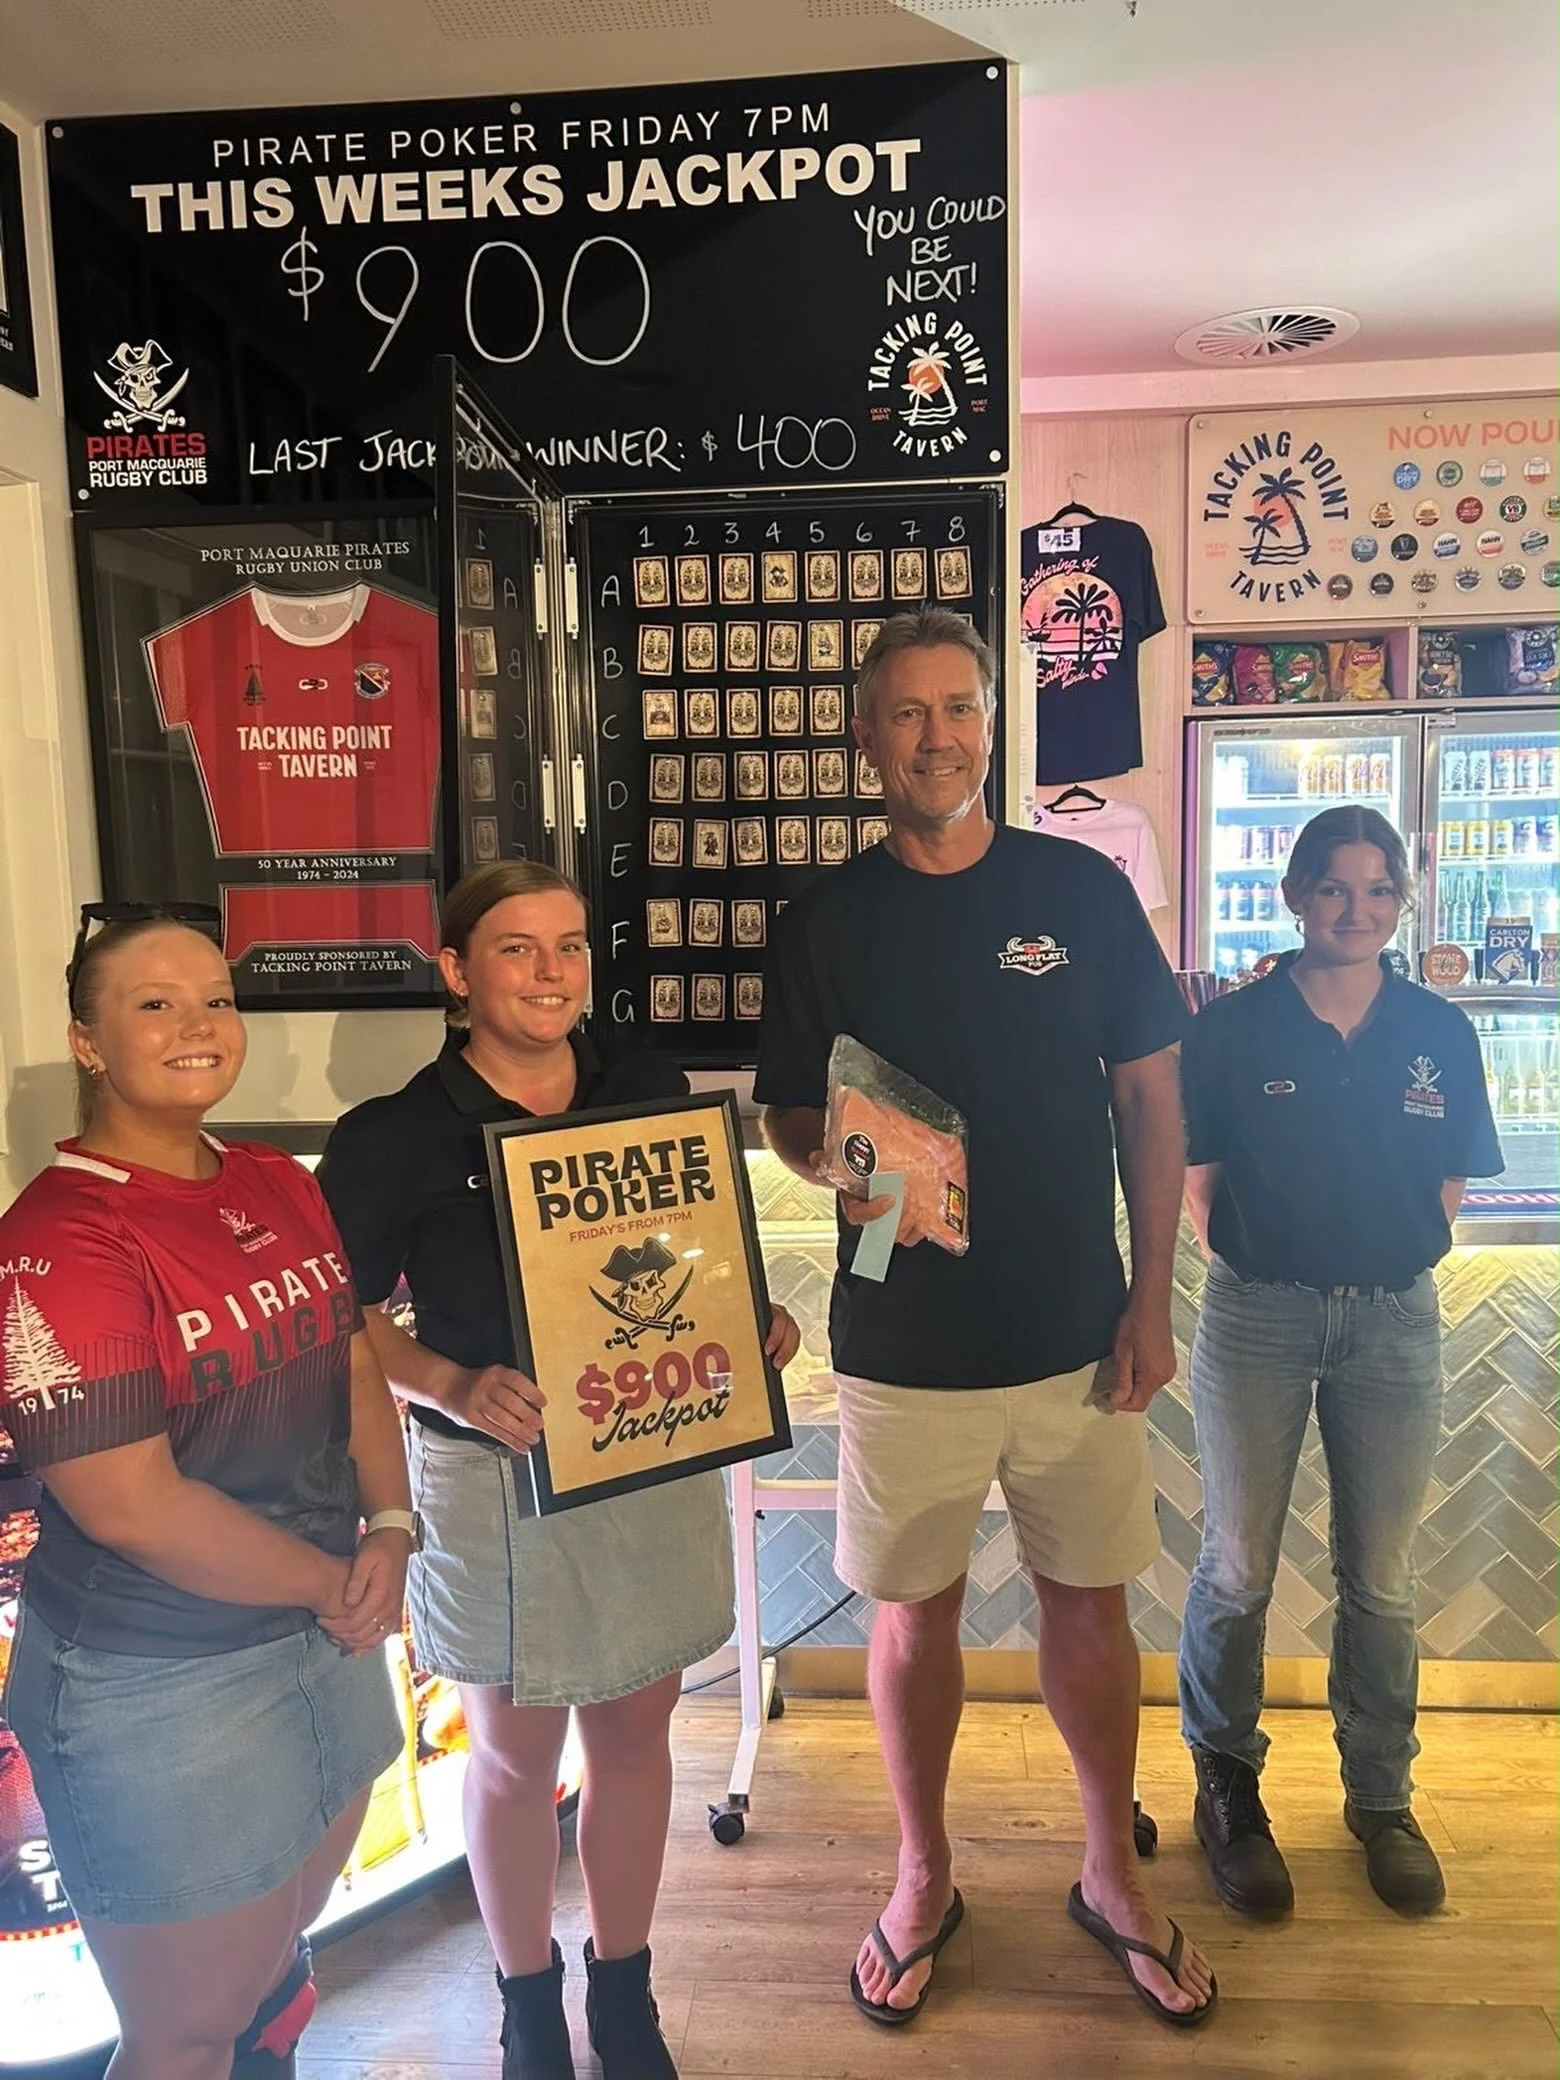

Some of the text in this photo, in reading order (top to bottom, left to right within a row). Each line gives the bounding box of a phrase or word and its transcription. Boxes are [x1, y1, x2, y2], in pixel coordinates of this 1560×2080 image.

[214, 102, 829, 167] PIRATE POKER FRIDAY 7PM
[131, 138, 921, 233] THIS WEEKS JACKPOT
[853, 195, 1006, 256] YOU COULD
[911, 235, 953, 265] BE
[886, 262, 978, 306] NEXT!
[868, 311, 988, 391] TACKING POINT
[87, 432, 206, 459] PIRATES
[892, 426, 968, 457] TAVERN
[1389, 418, 1560, 450] NOW POU
[89, 457, 207, 472] PORT MACQUARIE
[248, 436, 343, 475] LAST
[526, 427, 686, 472] WINNER:
[90, 469, 207, 488] RUGBY CLUB
[1204, 430, 1350, 522] TACKING POINT
[639, 515, 966, 547] 1 2 3 4 5 6 7 8
[201, 541, 410, 562] PORT MAQUARIE PIRATES
[236, 558, 382, 575] RUGBY UNION CLUB
[601, 574, 620, 607] A
[1230, 568, 1321, 602] TAVERN
[603, 648, 623, 678] B
[237, 725, 392, 750] TACKING POINT
[602, 714, 620, 740] C
[278, 754, 358, 778] TAVERN
[608, 781, 628, 809] D
[258, 856, 397, 869] 50 YEAR ANNIVERSARY
[297, 870, 320, 880] 1974
[333, 870, 359, 880] 2024
[610, 843, 632, 877] E
[611, 921, 629, 959] F
[1489, 928, 1530, 936] CARLTON
[1489, 936, 1529, 948] DRY
[251, 960, 412, 973] TACKING POINT TAVERN
[264, 951, 397, 961] PROUDLY SPONSORED BY
[612, 988, 634, 1022] G
[529, 1134, 710, 1195] PIRATE
[534, 1168, 716, 1231] POKER
[569, 1210, 693, 1243] FRIDAY'S FROM 7PM
[575, 1341, 733, 1426] $900
[18, 1385, 85, 1416] 19 74
[592, 1386, 731, 1452] Jackpot
